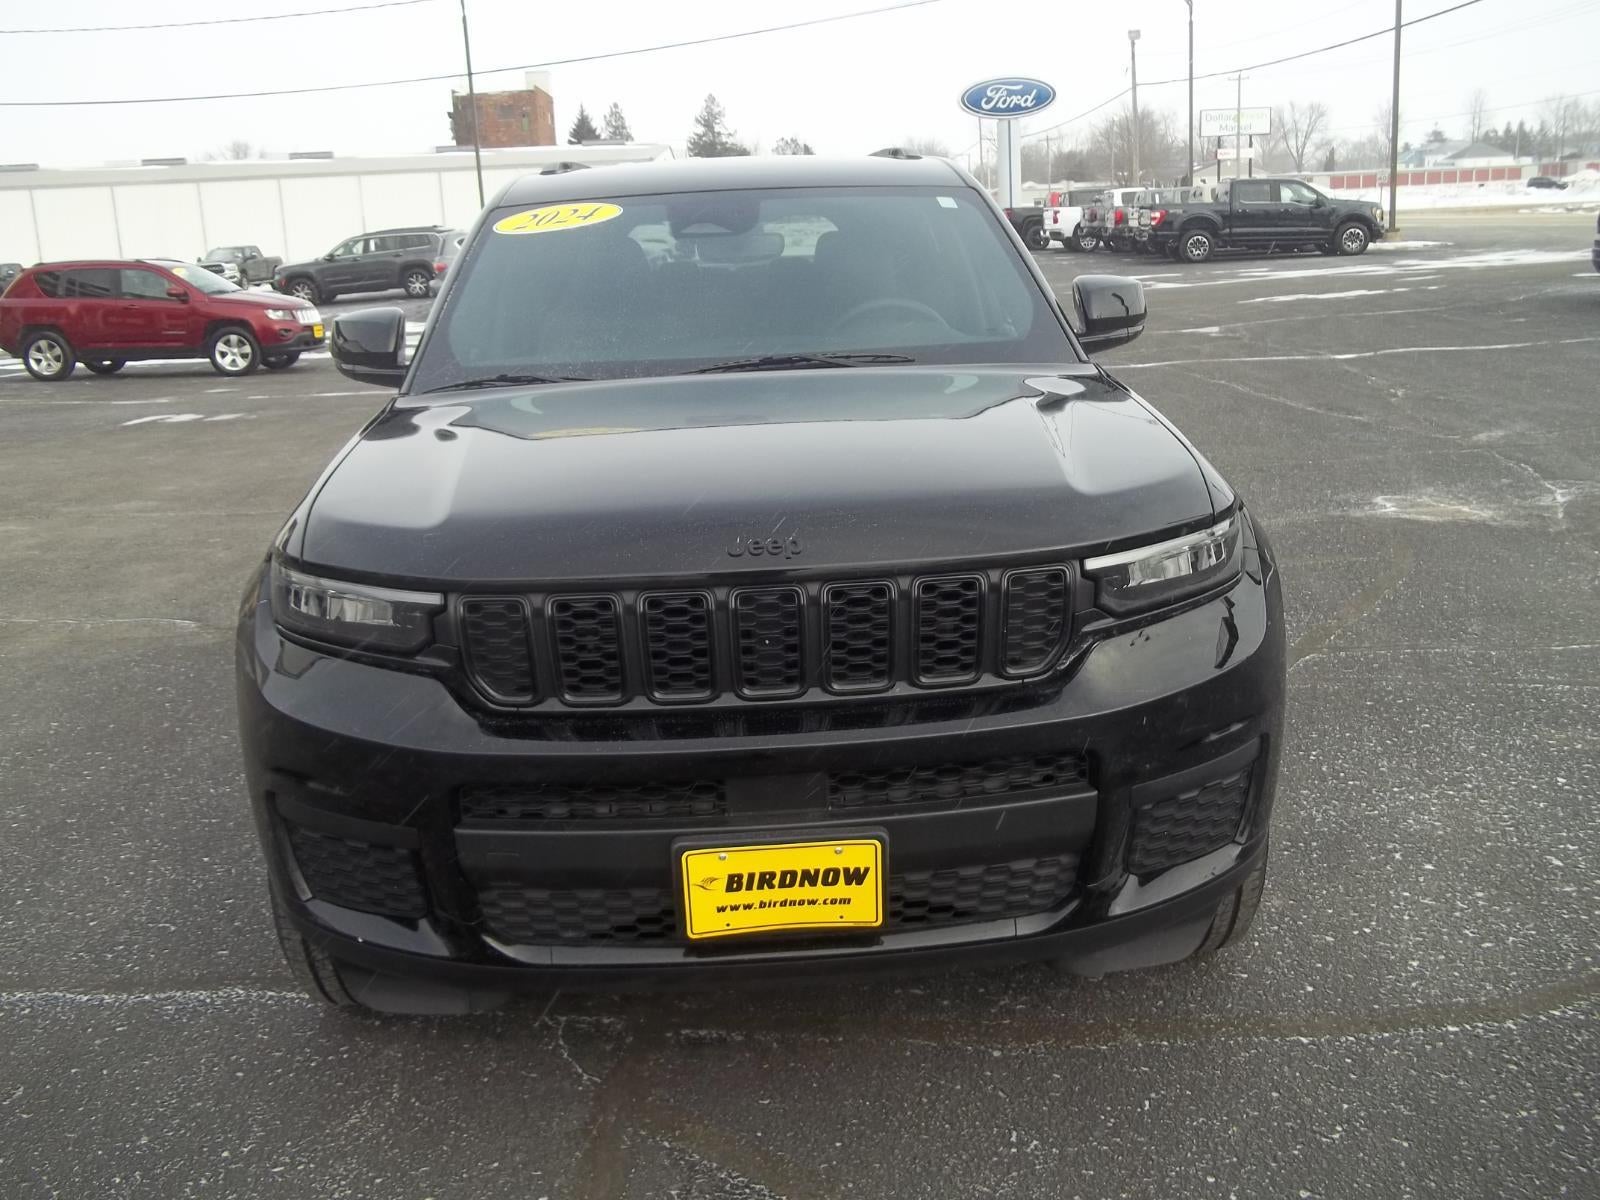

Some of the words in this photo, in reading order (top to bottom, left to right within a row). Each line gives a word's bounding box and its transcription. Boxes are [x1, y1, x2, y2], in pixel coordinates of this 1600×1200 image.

[981, 84, 1037, 110] Ford
[513, 206, 602, 229] 2024
[726, 535, 802, 560] Jeep
[725, 866, 871, 893] BIRDNOW
[716, 897, 852, 913] www.birdnow.com
